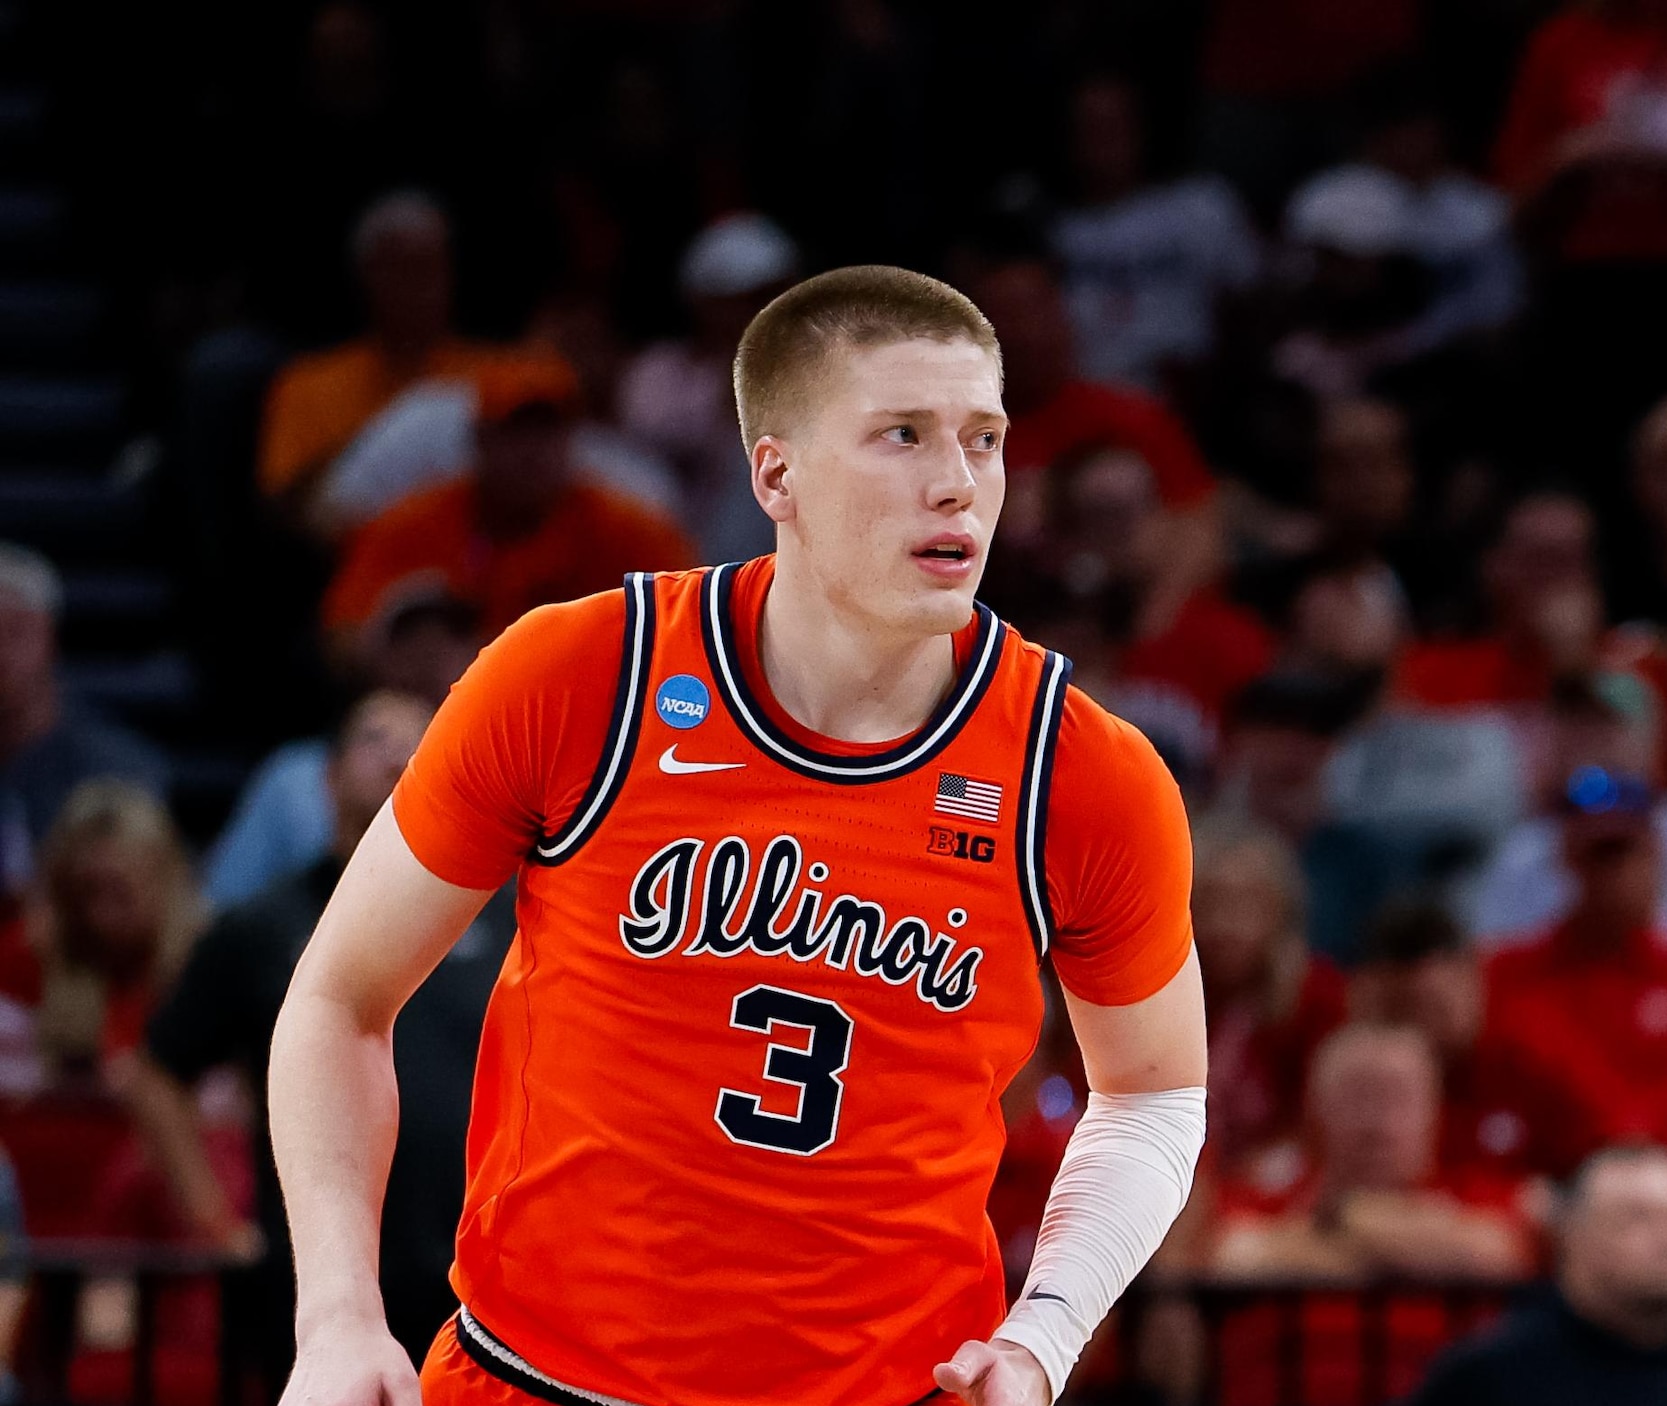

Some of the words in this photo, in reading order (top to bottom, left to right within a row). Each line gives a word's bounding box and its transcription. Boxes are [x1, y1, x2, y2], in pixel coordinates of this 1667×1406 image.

[661, 696, 705, 719] NCAA
[619, 834, 984, 1012] Illinois
[713, 984, 853, 1157] 3
